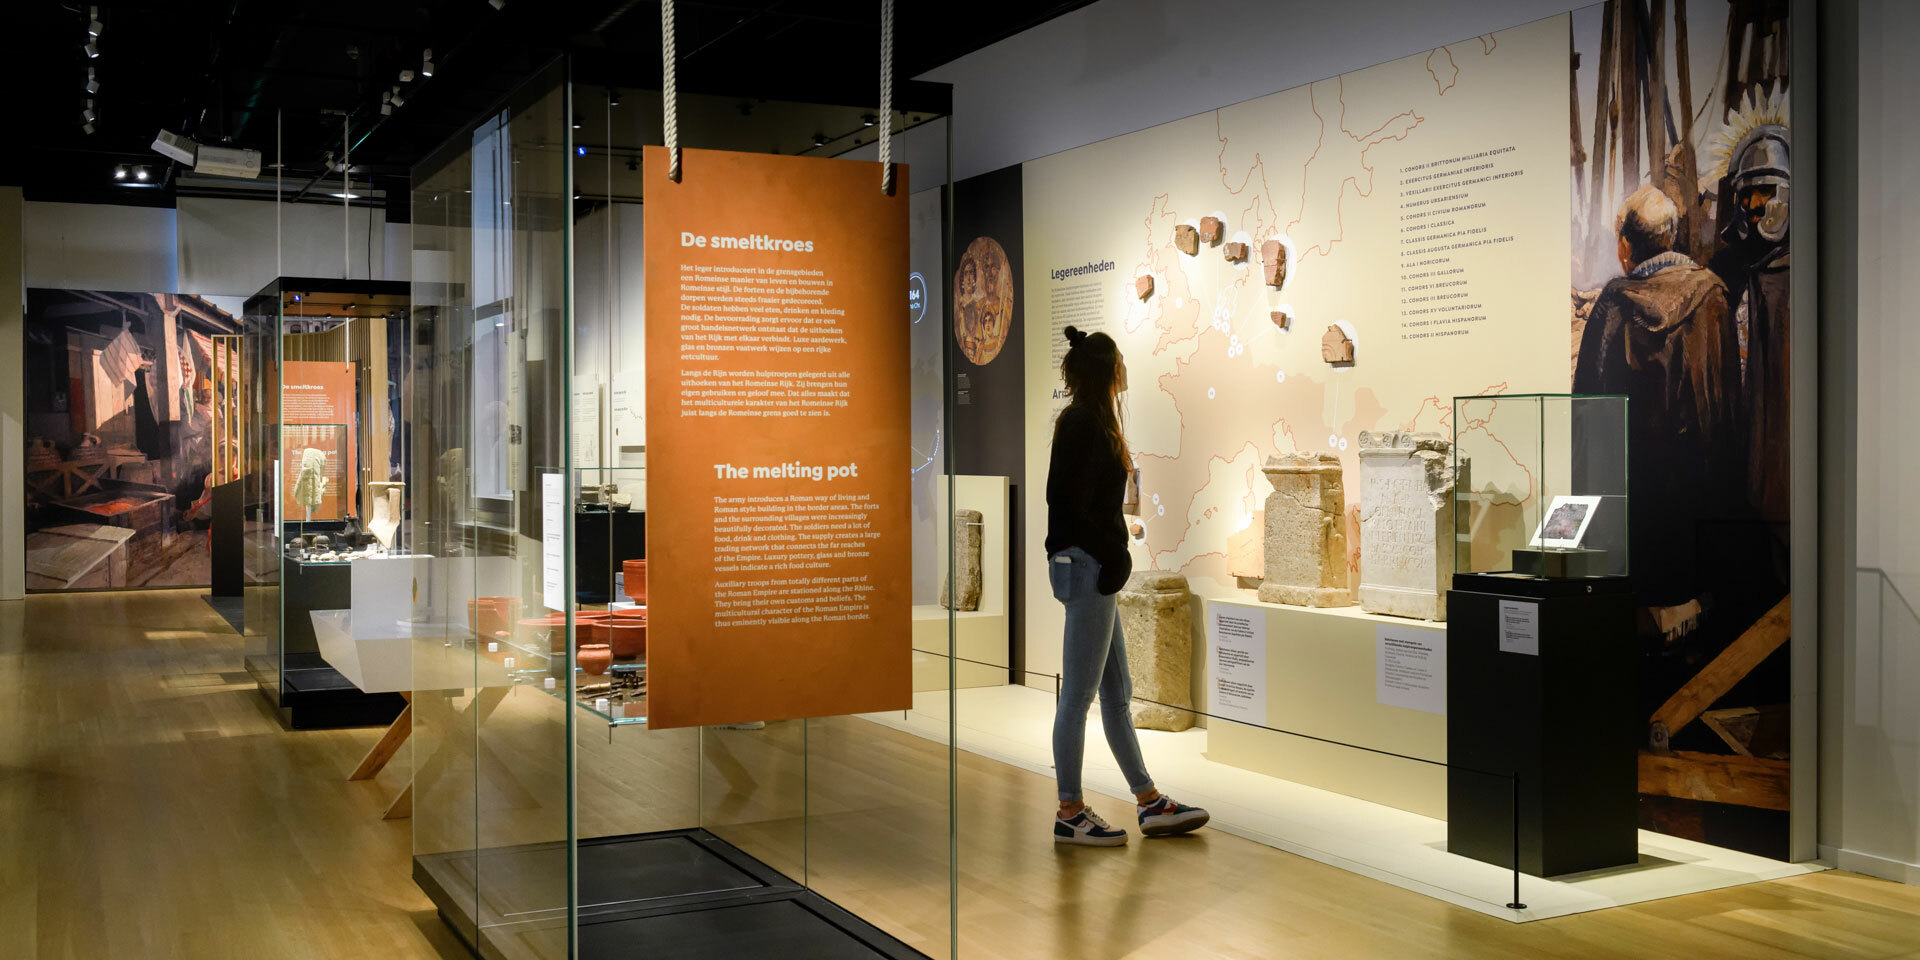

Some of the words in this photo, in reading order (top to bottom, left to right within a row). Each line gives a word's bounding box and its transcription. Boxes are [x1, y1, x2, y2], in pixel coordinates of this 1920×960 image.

[681, 232, 706, 249] De
[711, 234, 814, 252] smeltkroes
[695, 265, 712, 275] leger
[714, 266, 757, 274] introduceert
[776, 268, 824, 278] grensgebieden
[1051, 260, 1115, 281] Legereenheden
[716, 286, 731, 295] stijl.
[786, 288, 830, 298] bijbehorende
[681, 295, 706, 304] dorpen
[781, 297, 823, 307] gedecoreerd.
[765, 306, 782, 316] eten,
[821, 308, 845, 317] kleding
[714, 464, 748, 480] The
[753, 461, 823, 481] melting
[828, 462, 858, 481] pot
[838, 494, 857, 503] living
[740, 505, 756, 514] style
[758, 505, 786, 514] building
[742, 514, 783, 524] surrounding
[784, 514, 810, 523] villages
[829, 513, 867, 522] increasingly
[714, 524, 752, 534] beautifully
[715, 535, 732, 544] food,
[768, 533, 797, 542] clothing.
[812, 532, 834, 542] supply
[865, 531, 880, 540] large
[715, 544, 740, 554] trading
[737, 553, 762, 563] Empire.
[764, 553, 788, 562] Luxury
[789, 552, 815, 561] pottery,
[816, 552, 833, 561] glass
